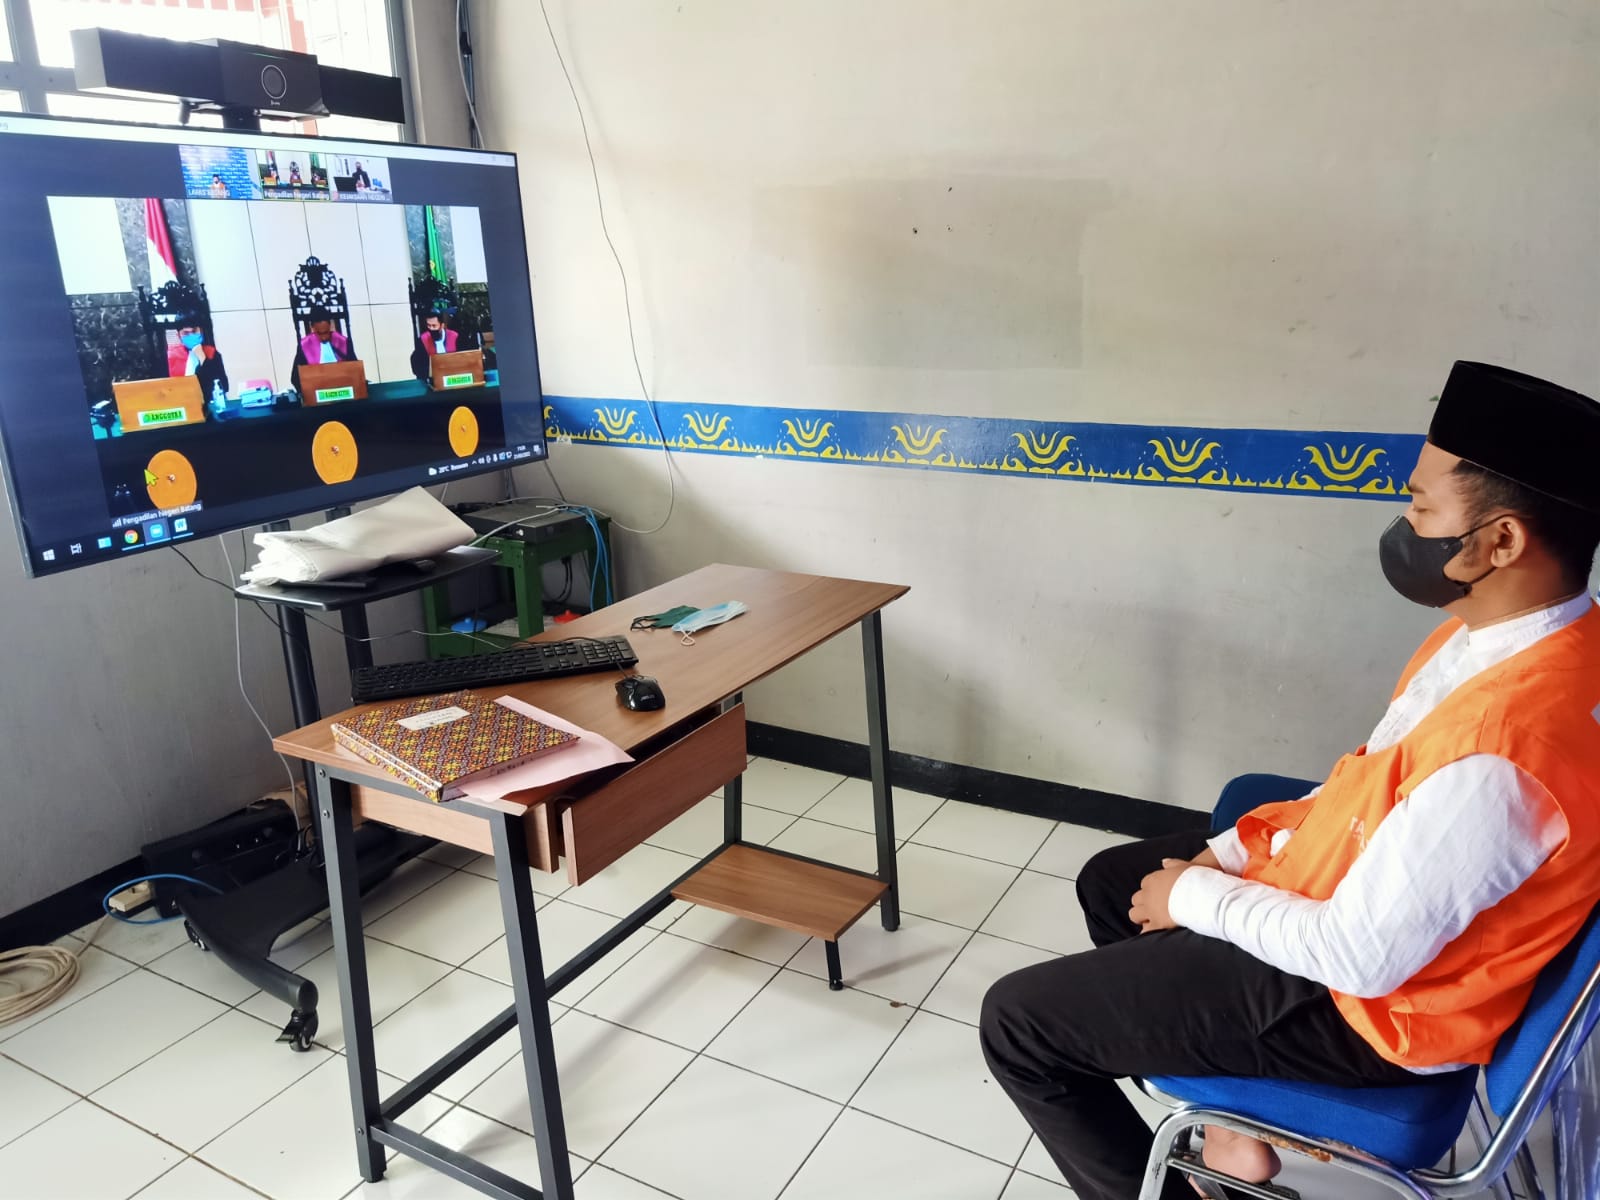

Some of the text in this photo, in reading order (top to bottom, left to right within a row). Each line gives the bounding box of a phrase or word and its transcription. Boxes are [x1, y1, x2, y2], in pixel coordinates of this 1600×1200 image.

[123, 503, 202, 525] Pengadilan Negeri Batang
